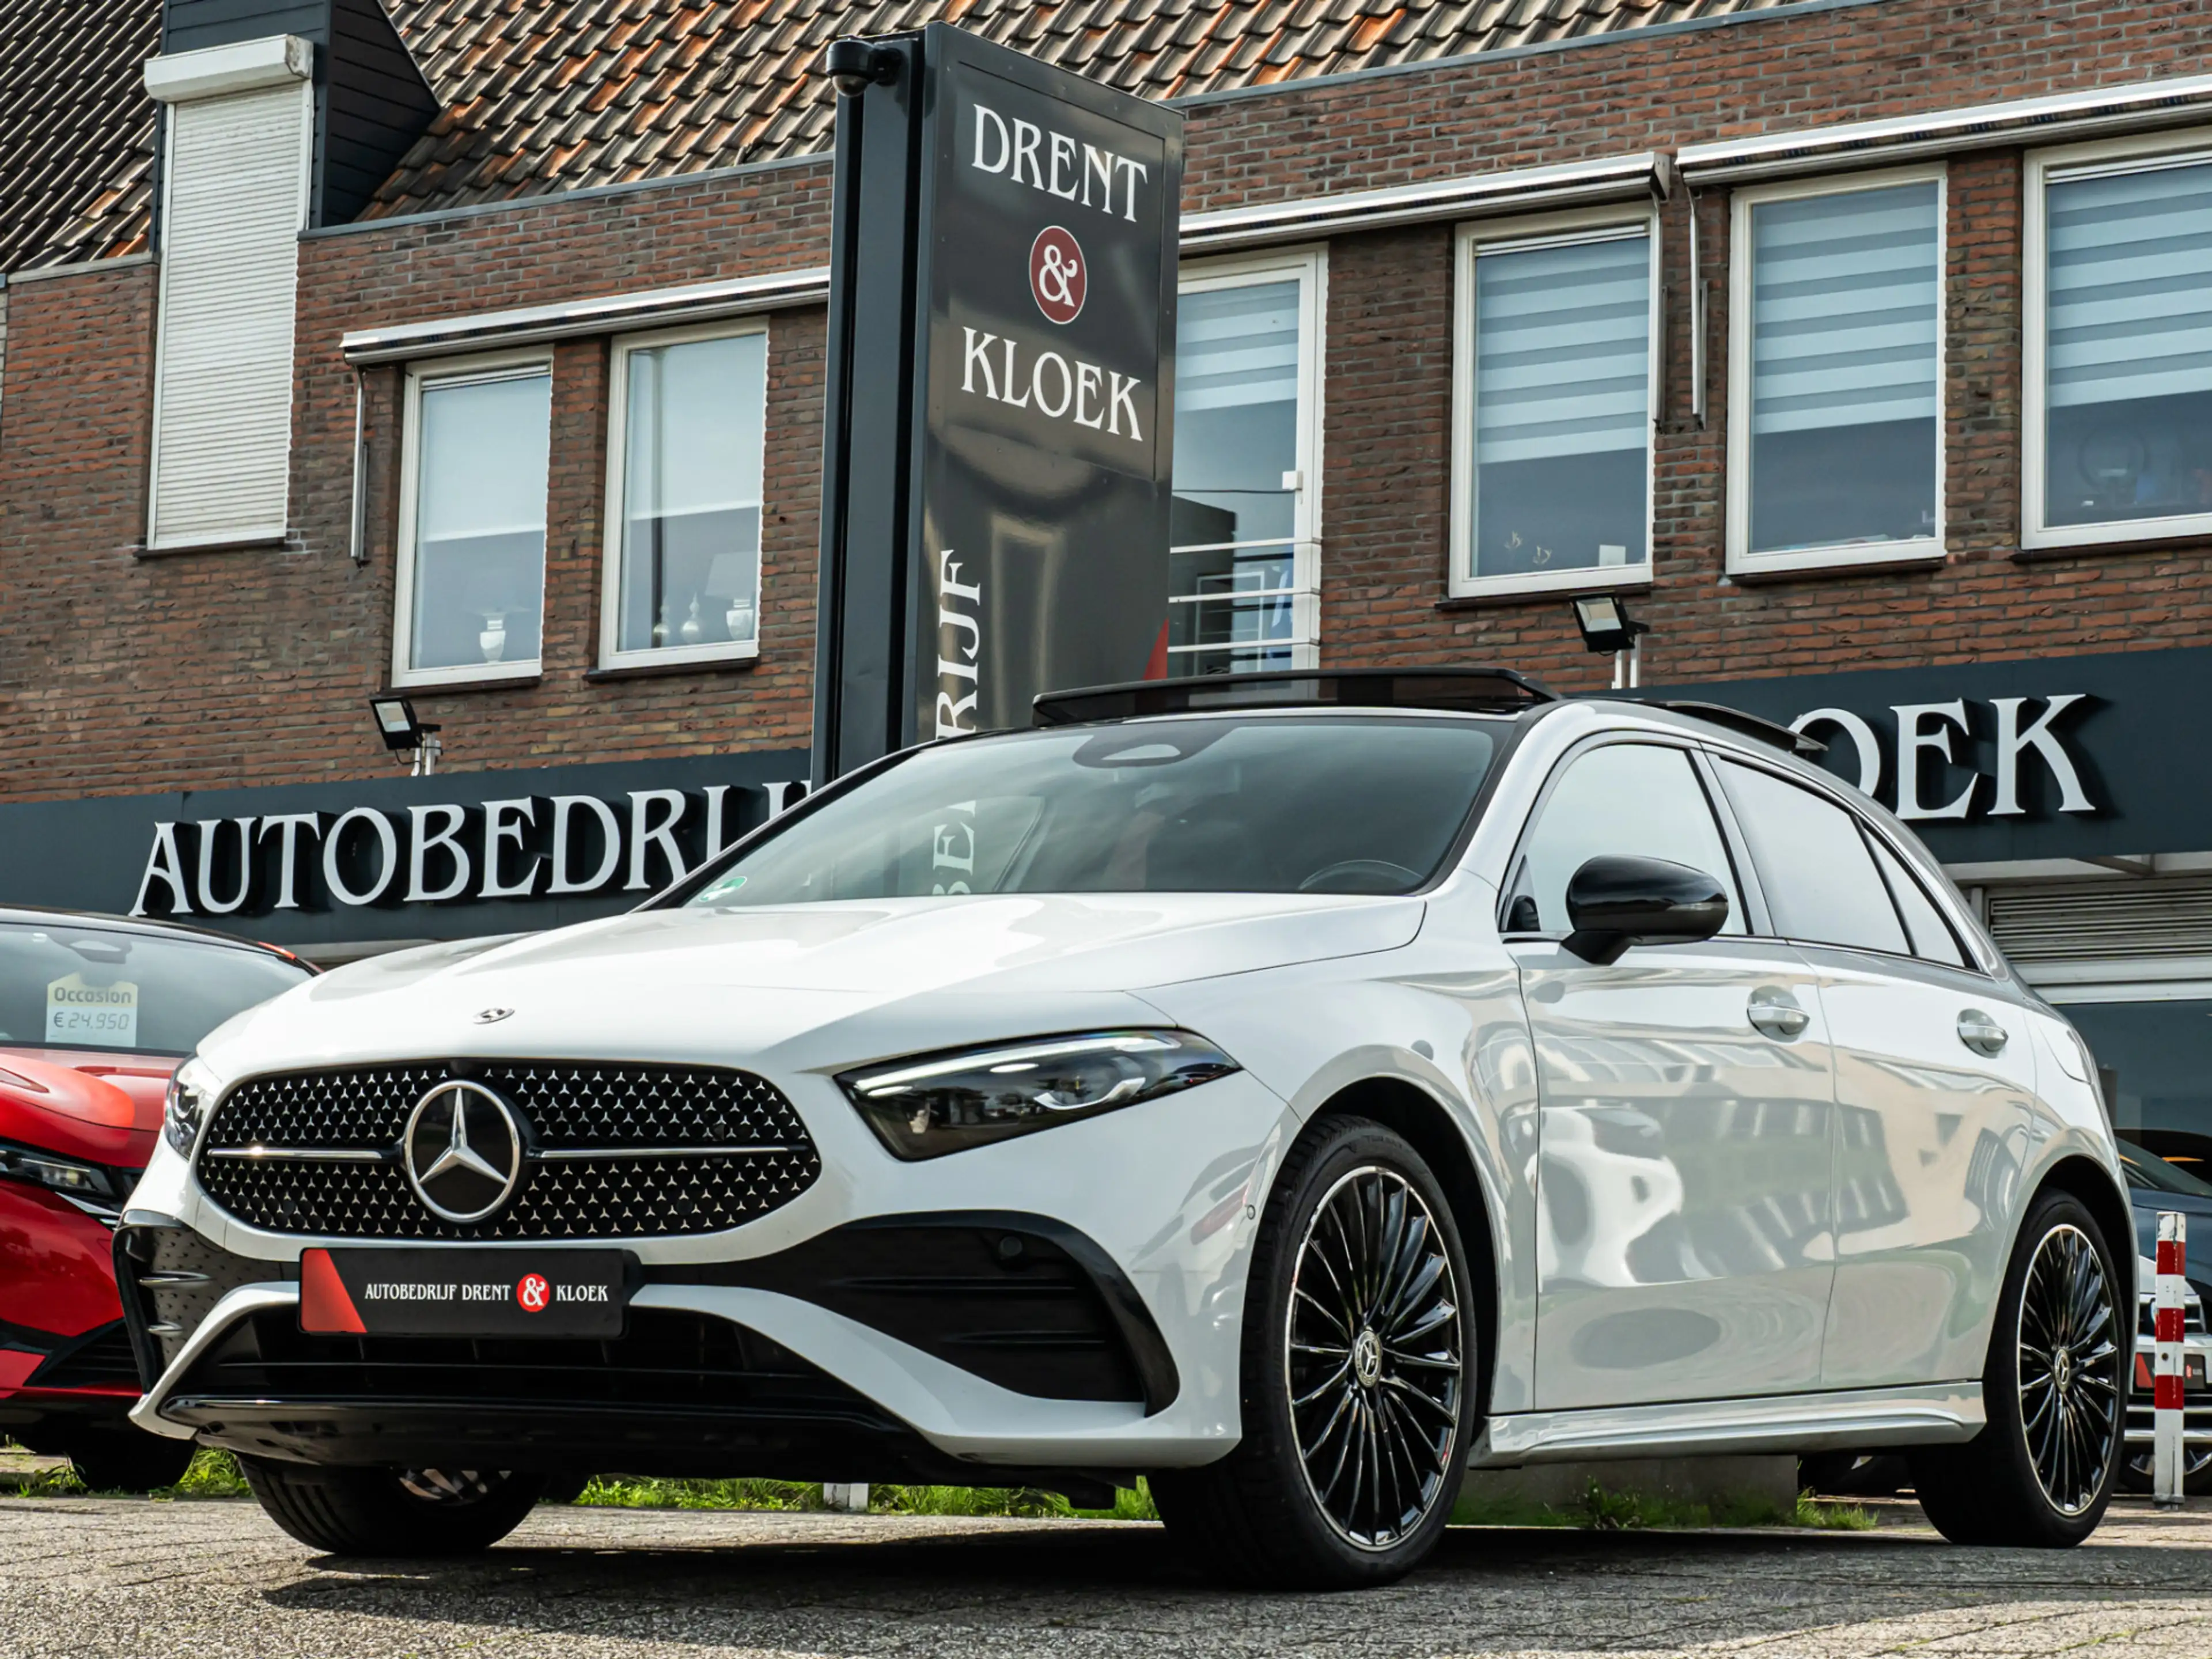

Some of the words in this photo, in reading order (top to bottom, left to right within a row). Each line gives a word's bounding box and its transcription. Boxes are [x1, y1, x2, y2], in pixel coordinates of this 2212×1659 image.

[972, 104, 1147, 223] DRENT
[1038, 244, 1078, 307] &
[960, 325, 1143, 442] KLOEK
[54, 987, 132, 1004] Occasion
[365, 1283, 458, 1301] AUTOBEDRIJF
[462, 1284, 512, 1302] DRENT
[523, 1276, 546, 1306] &
[556, 1285, 609, 1302] KLOEK
